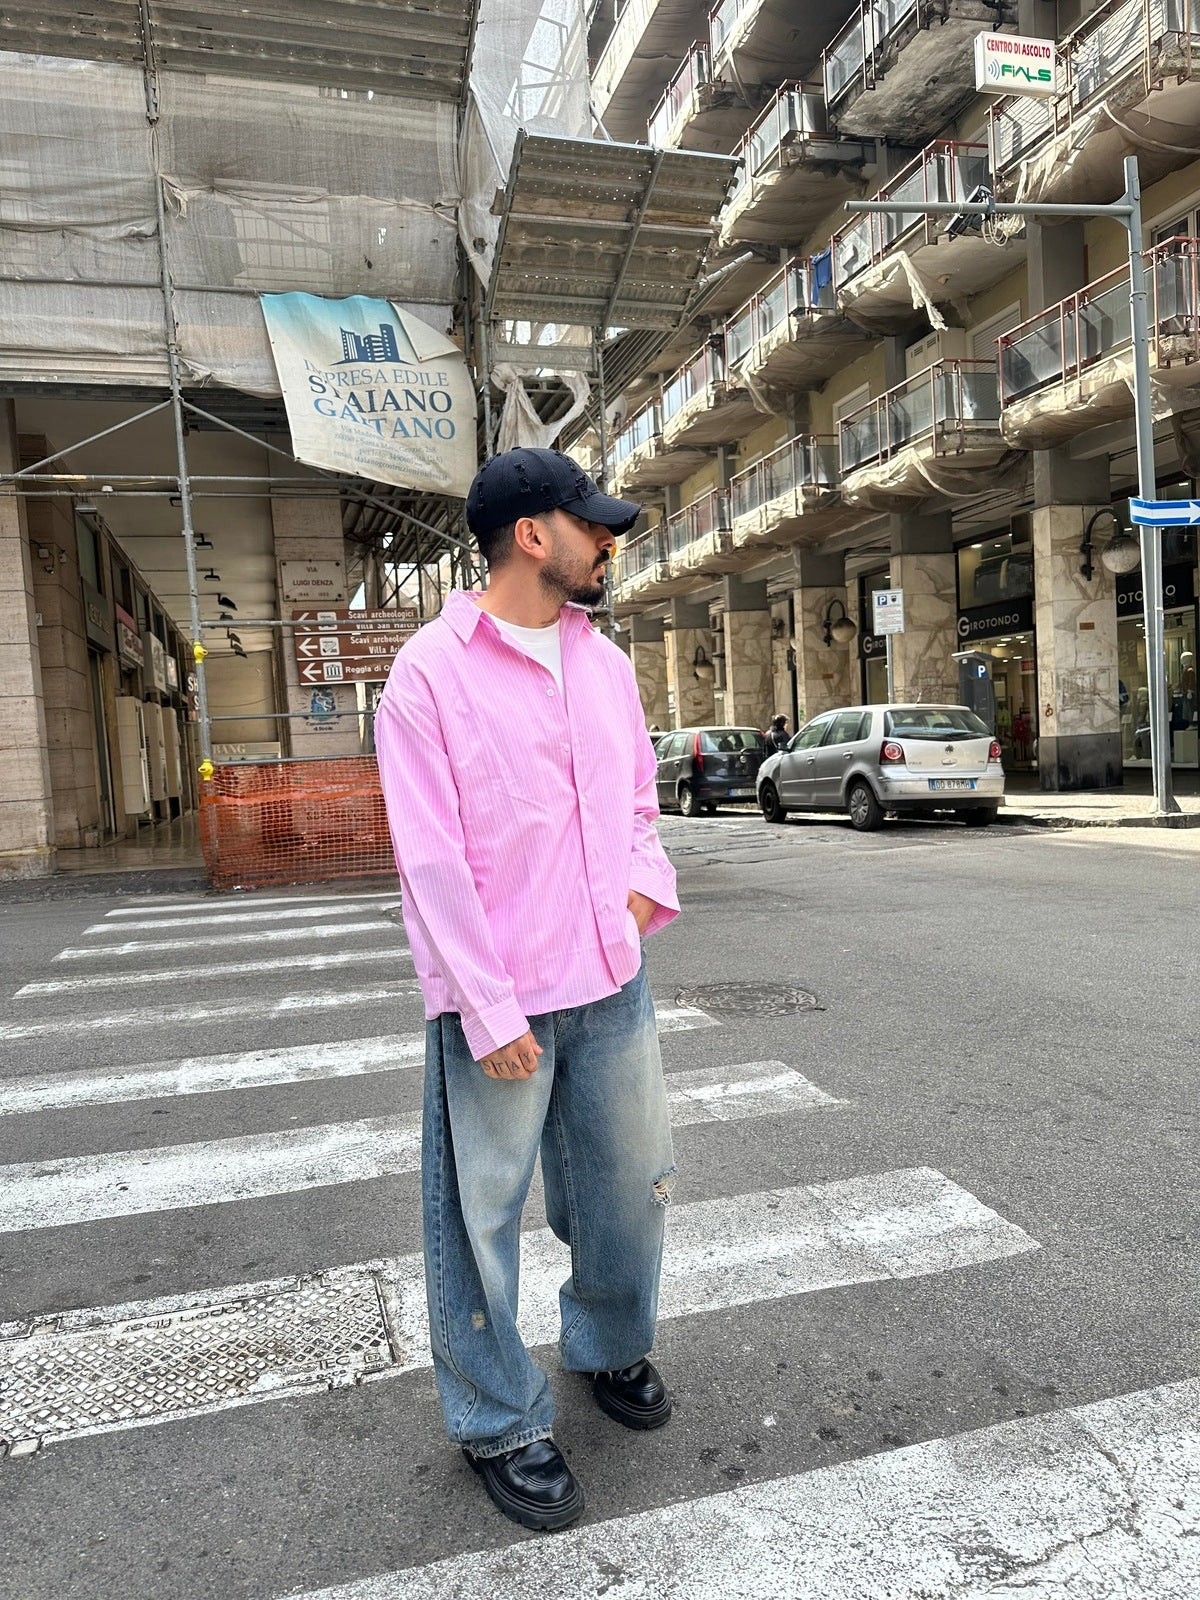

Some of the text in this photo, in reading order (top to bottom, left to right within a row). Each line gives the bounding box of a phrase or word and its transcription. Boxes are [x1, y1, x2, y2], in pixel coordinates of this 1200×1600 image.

[987, 39, 1051, 58] CENTRO DI ASCOLTO
[393, 370, 449, 386] EDILE
[313, 398, 456, 439] GATANO
[348, 609, 414, 620] Scavi archeologici
[957, 613, 1020, 637] GIROTONDO
[350, 633, 411, 644] Scavi archeolog
[863, 636, 887, 653] GIRO
[369, 645, 400, 654] Villa Ari
[345, 666, 371, 674] Reggia
[383, 664, 391, 672] Q
[187, 676, 199, 692] SH
[483, 1052, 531, 1073] STAY
